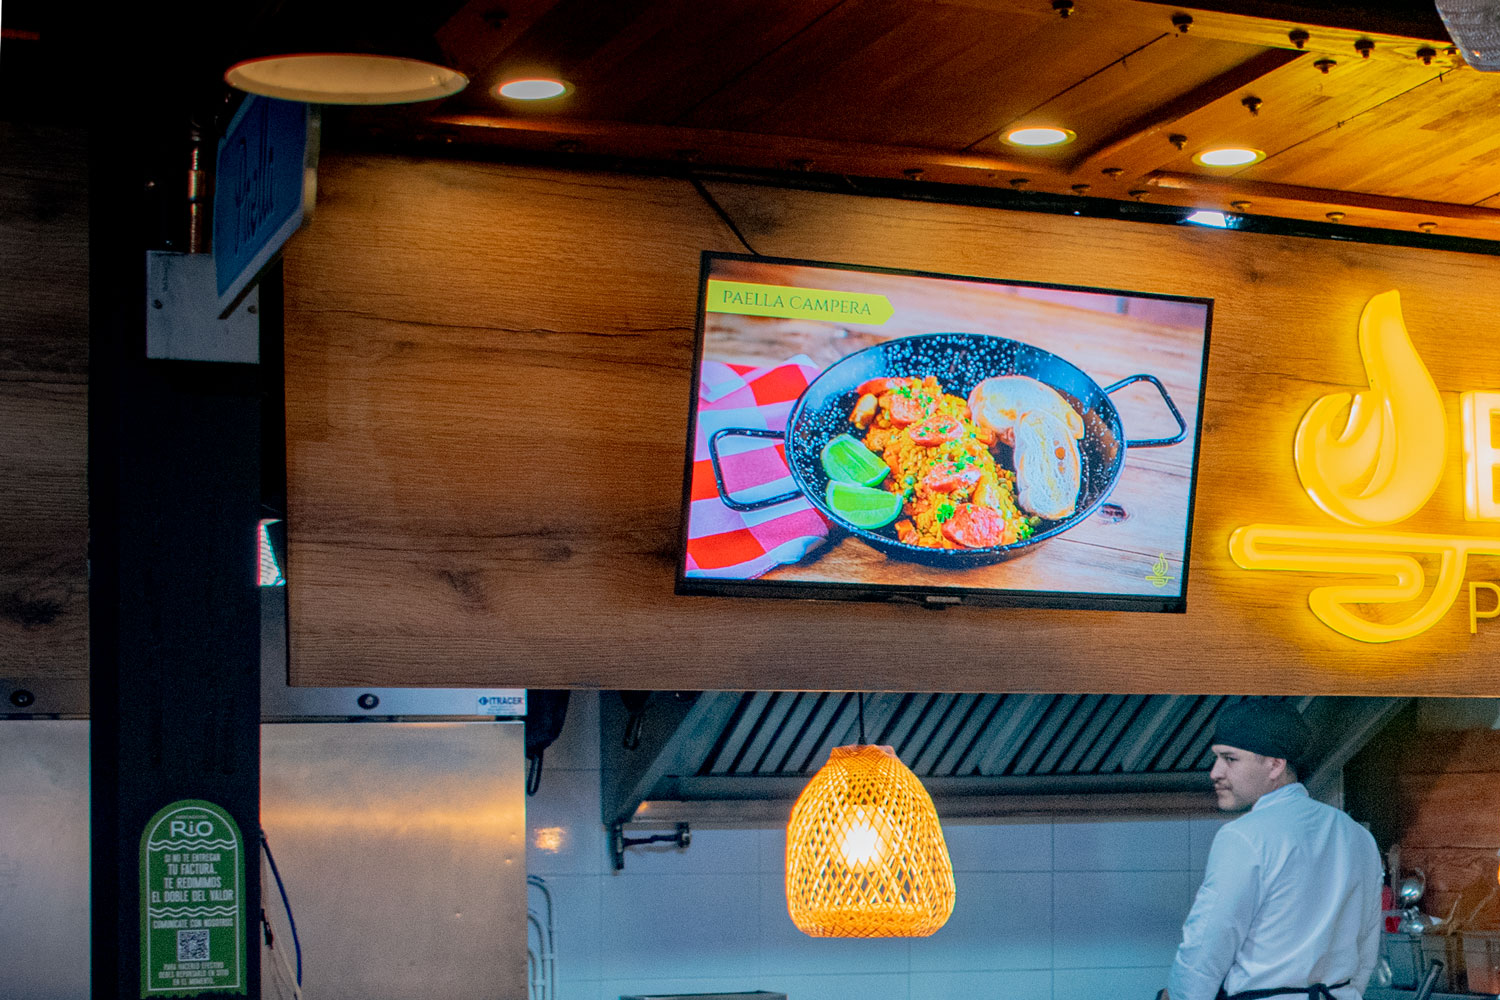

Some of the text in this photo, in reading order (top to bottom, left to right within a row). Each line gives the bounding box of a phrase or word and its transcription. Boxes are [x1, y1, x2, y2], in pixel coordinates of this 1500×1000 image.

[722, 289, 872, 316] PAELLA CAMPERA
[182, 853, 190, 862] TE
[168, 863, 178, 875] TU
[163, 876, 222, 889] TE REDIMIMOS
[151, 888, 234, 903] EL DOBLE DEL VALOR
